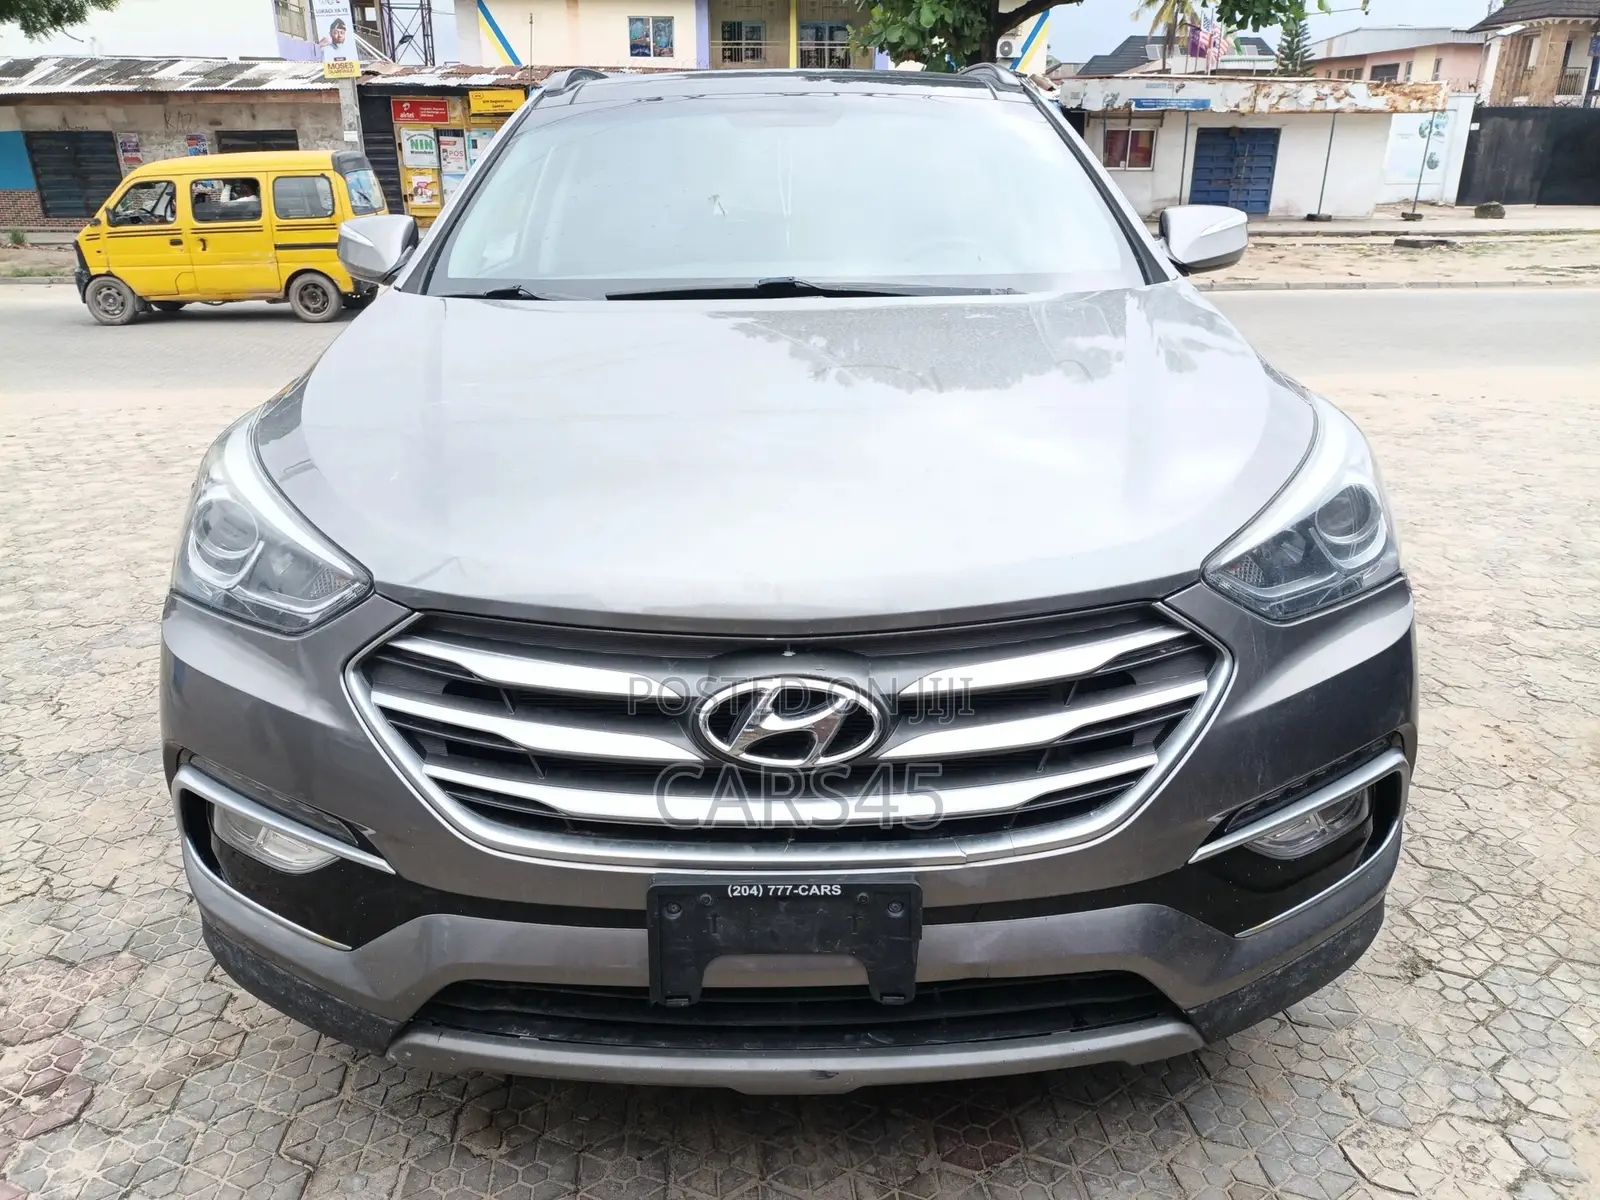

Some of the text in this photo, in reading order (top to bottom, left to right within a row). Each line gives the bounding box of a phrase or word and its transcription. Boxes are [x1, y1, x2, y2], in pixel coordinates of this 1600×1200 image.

[327, 62, 354, 70] MOSES
[410, 139, 434, 150] NIN
[727, 884, 842, 898] (204) 777-CARS
